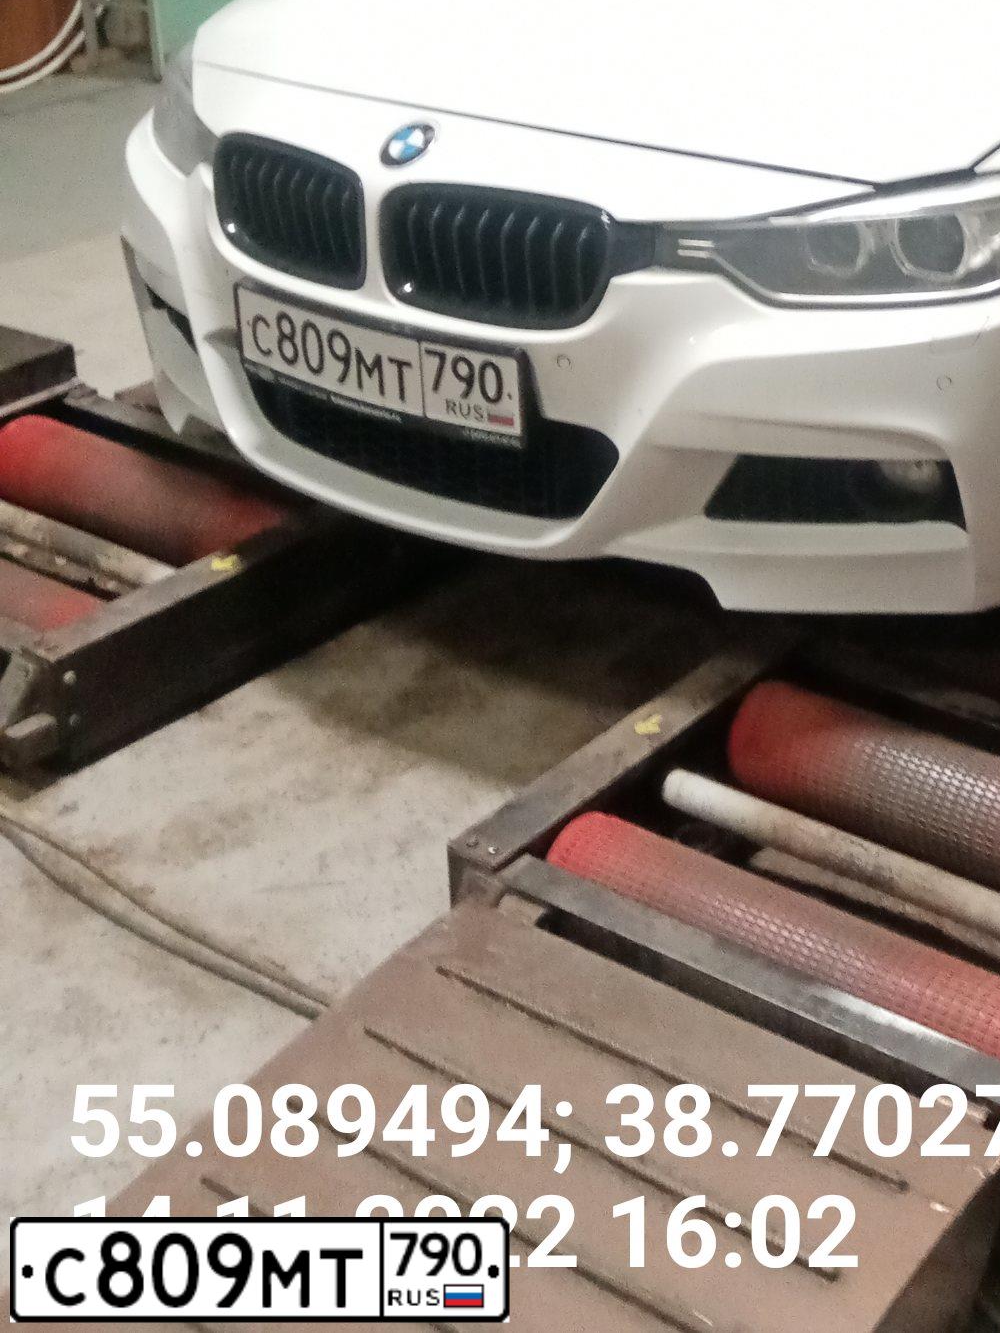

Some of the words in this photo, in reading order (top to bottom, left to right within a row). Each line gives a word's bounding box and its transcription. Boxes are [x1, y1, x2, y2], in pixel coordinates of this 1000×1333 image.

[251, 311, 412, 401] С809МТ
[424, 348, 503, 404] 790
[446, 399, 485, 423] RUS
